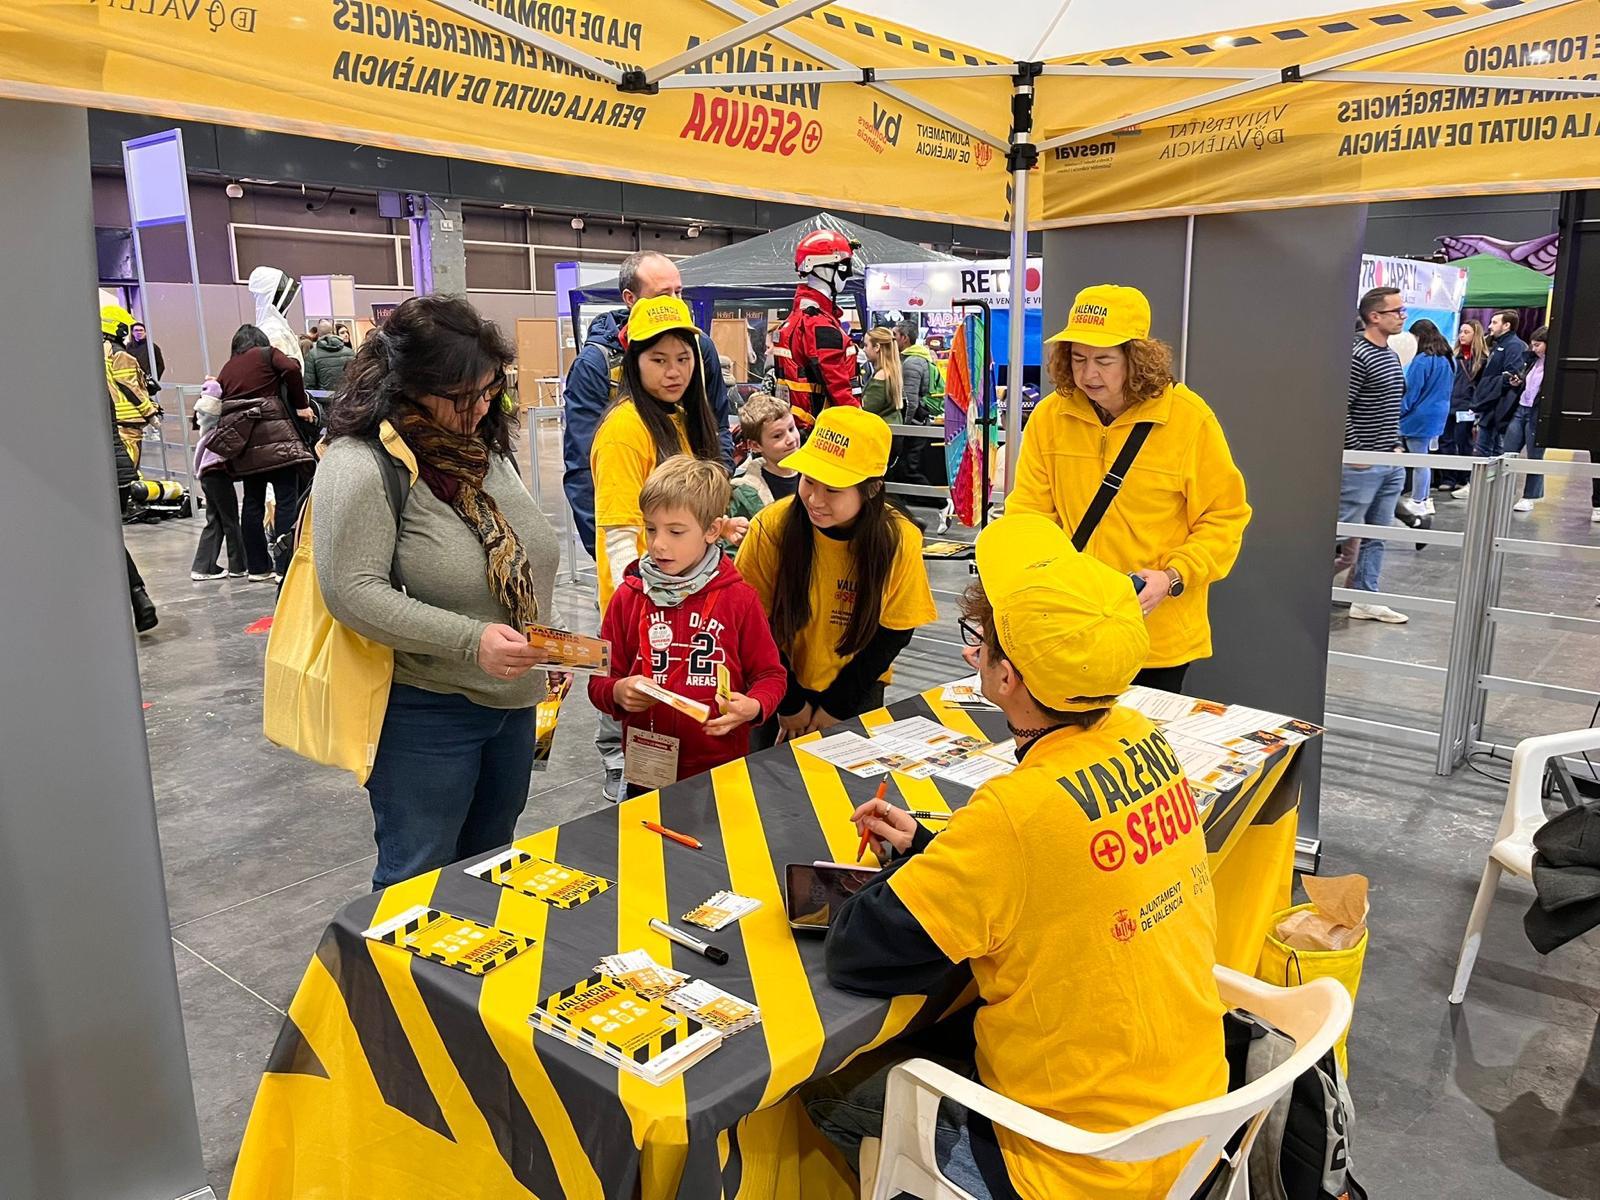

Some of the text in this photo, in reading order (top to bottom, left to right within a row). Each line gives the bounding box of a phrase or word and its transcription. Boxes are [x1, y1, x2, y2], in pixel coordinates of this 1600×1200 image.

[1075, 315, 1105, 326] SEGURA
[814, 439, 846, 458] SEGURA
[689, 632, 717, 676] 2
[685, 676, 717, 687] AREAS
[1139, 882, 1182, 918] AJUNTAMENT
[1141, 896, 1184, 932] DE VALÈNCIA
[573, 989, 620, 1014] SEGURA
